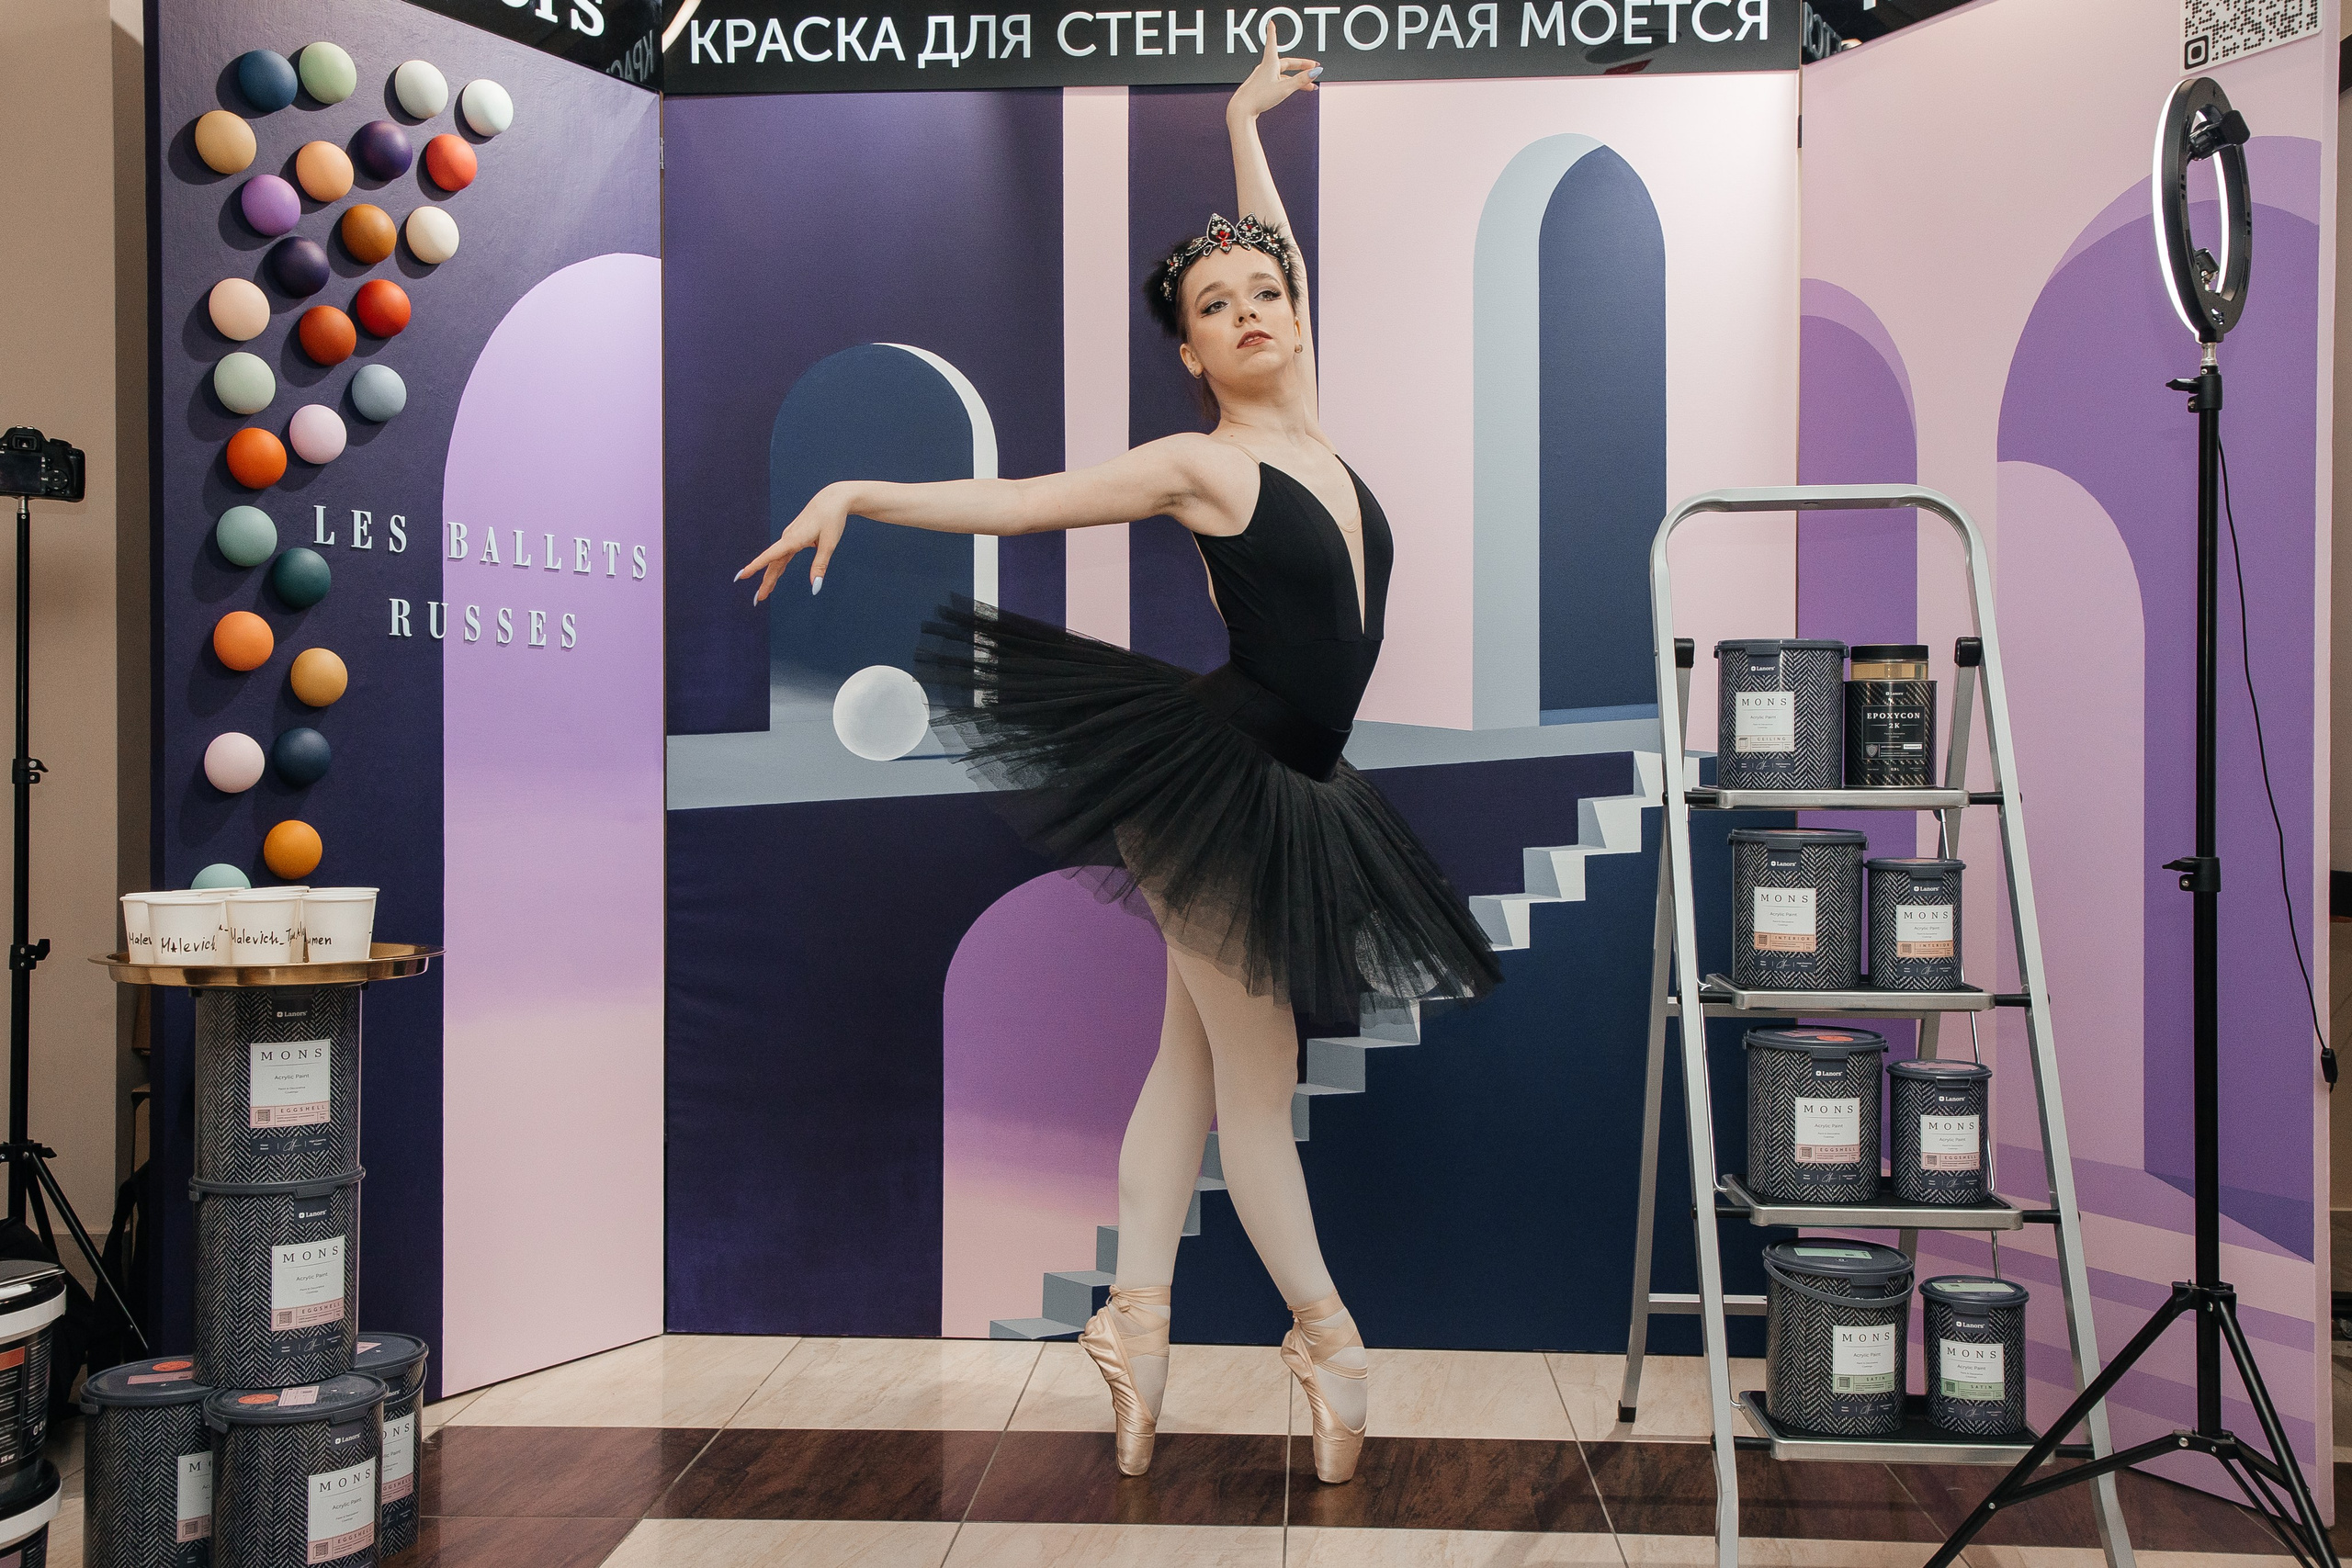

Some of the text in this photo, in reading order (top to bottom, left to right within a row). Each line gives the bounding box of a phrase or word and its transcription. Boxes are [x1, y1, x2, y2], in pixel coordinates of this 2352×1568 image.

[690, 0, 1768, 68] КРАСКА ДЛЯ СТЕН КОТОРАЯ МОЕТСЯ
[313, 505, 648, 581] LES BALLETS
[389, 598, 577, 649] RUSSES
[1741, 698, 1787, 706] MONS
[1760, 894, 1808, 903] MONS
[1904, 911, 1949, 919] MONS
[261, 1048, 322, 1061] MONS
[280, 1105, 325, 1113] EGGSHELL
[1804, 1105, 1854, 1113] MONS
[1928, 1122, 1974, 1130] MONS
[305, 1210, 327, 1218] Lanors
[283, 1246, 338, 1263] MONS
[301, 1303, 340, 1314] EGGSHELL
[1841, 1332, 1890, 1342] MONS
[1947, 1347, 1996, 1359] MONS
[342, 1433, 361, 1443] Lanors
[320, 1468, 371, 1493] MONS
[383, 1477, 412, 1491] GGSHELL
[333, 1502, 349, 1510] Acrylic
